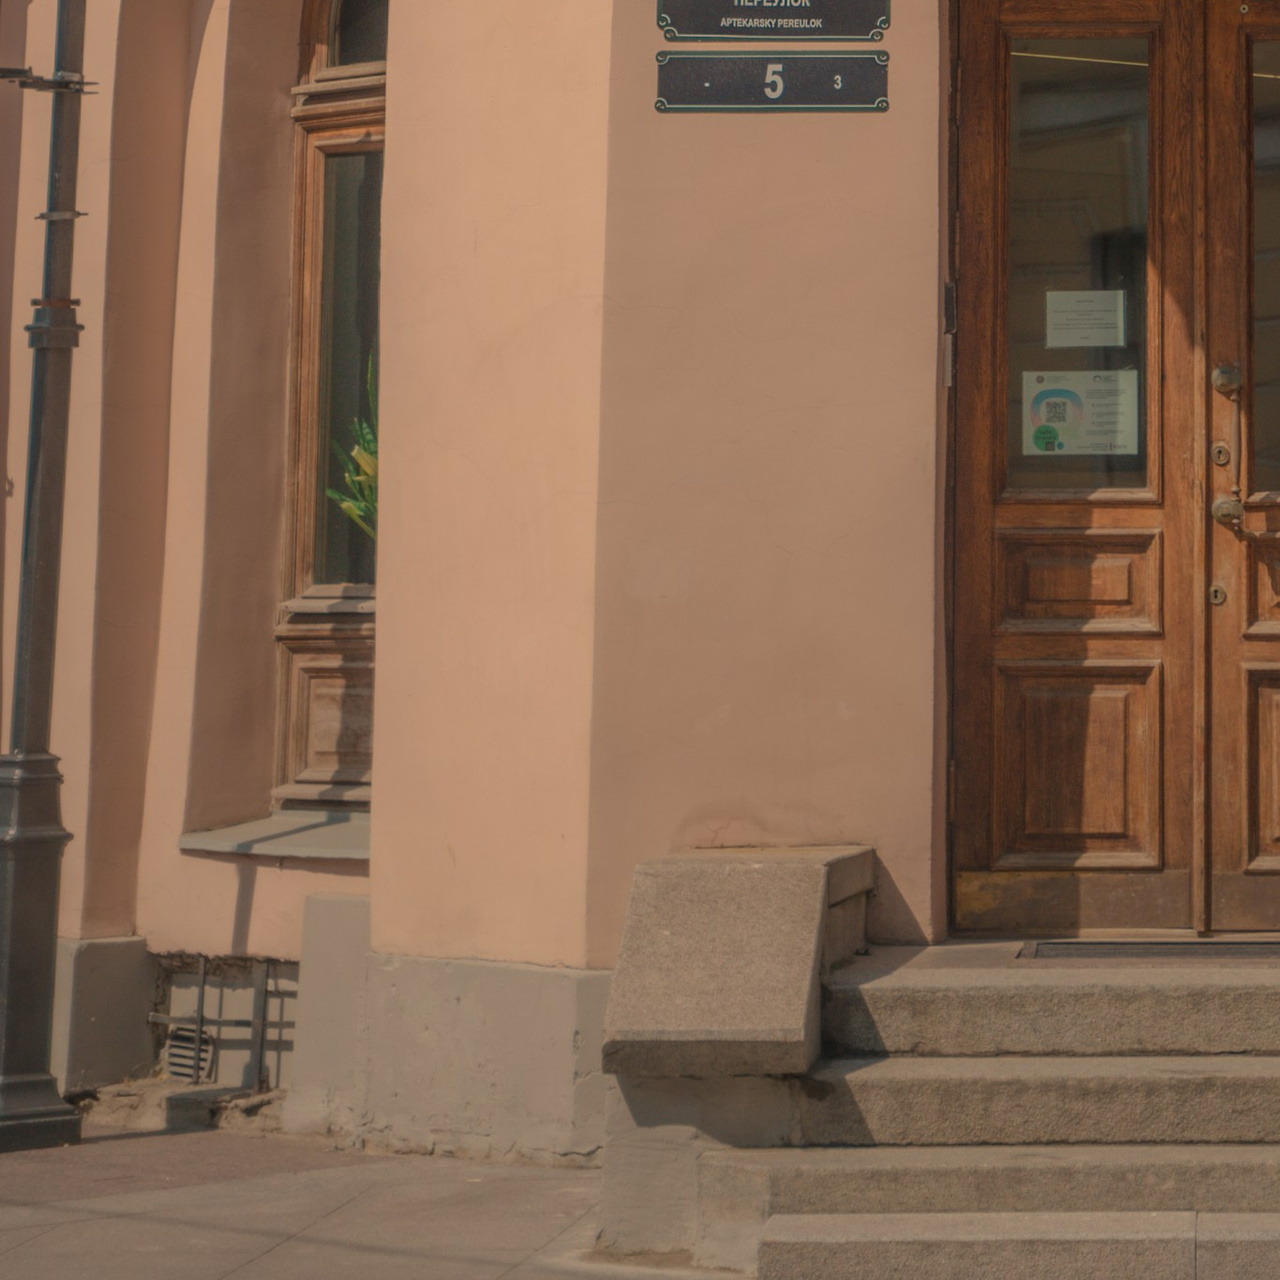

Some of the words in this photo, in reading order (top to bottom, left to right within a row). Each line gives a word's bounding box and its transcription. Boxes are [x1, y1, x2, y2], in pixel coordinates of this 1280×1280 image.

[721, 17, 776, 28] APTEKARSKY
[777, 19, 822, 28] PEREULOK
[764, 64, 784, 99] 5
[834, 75, 842, 89] 3
